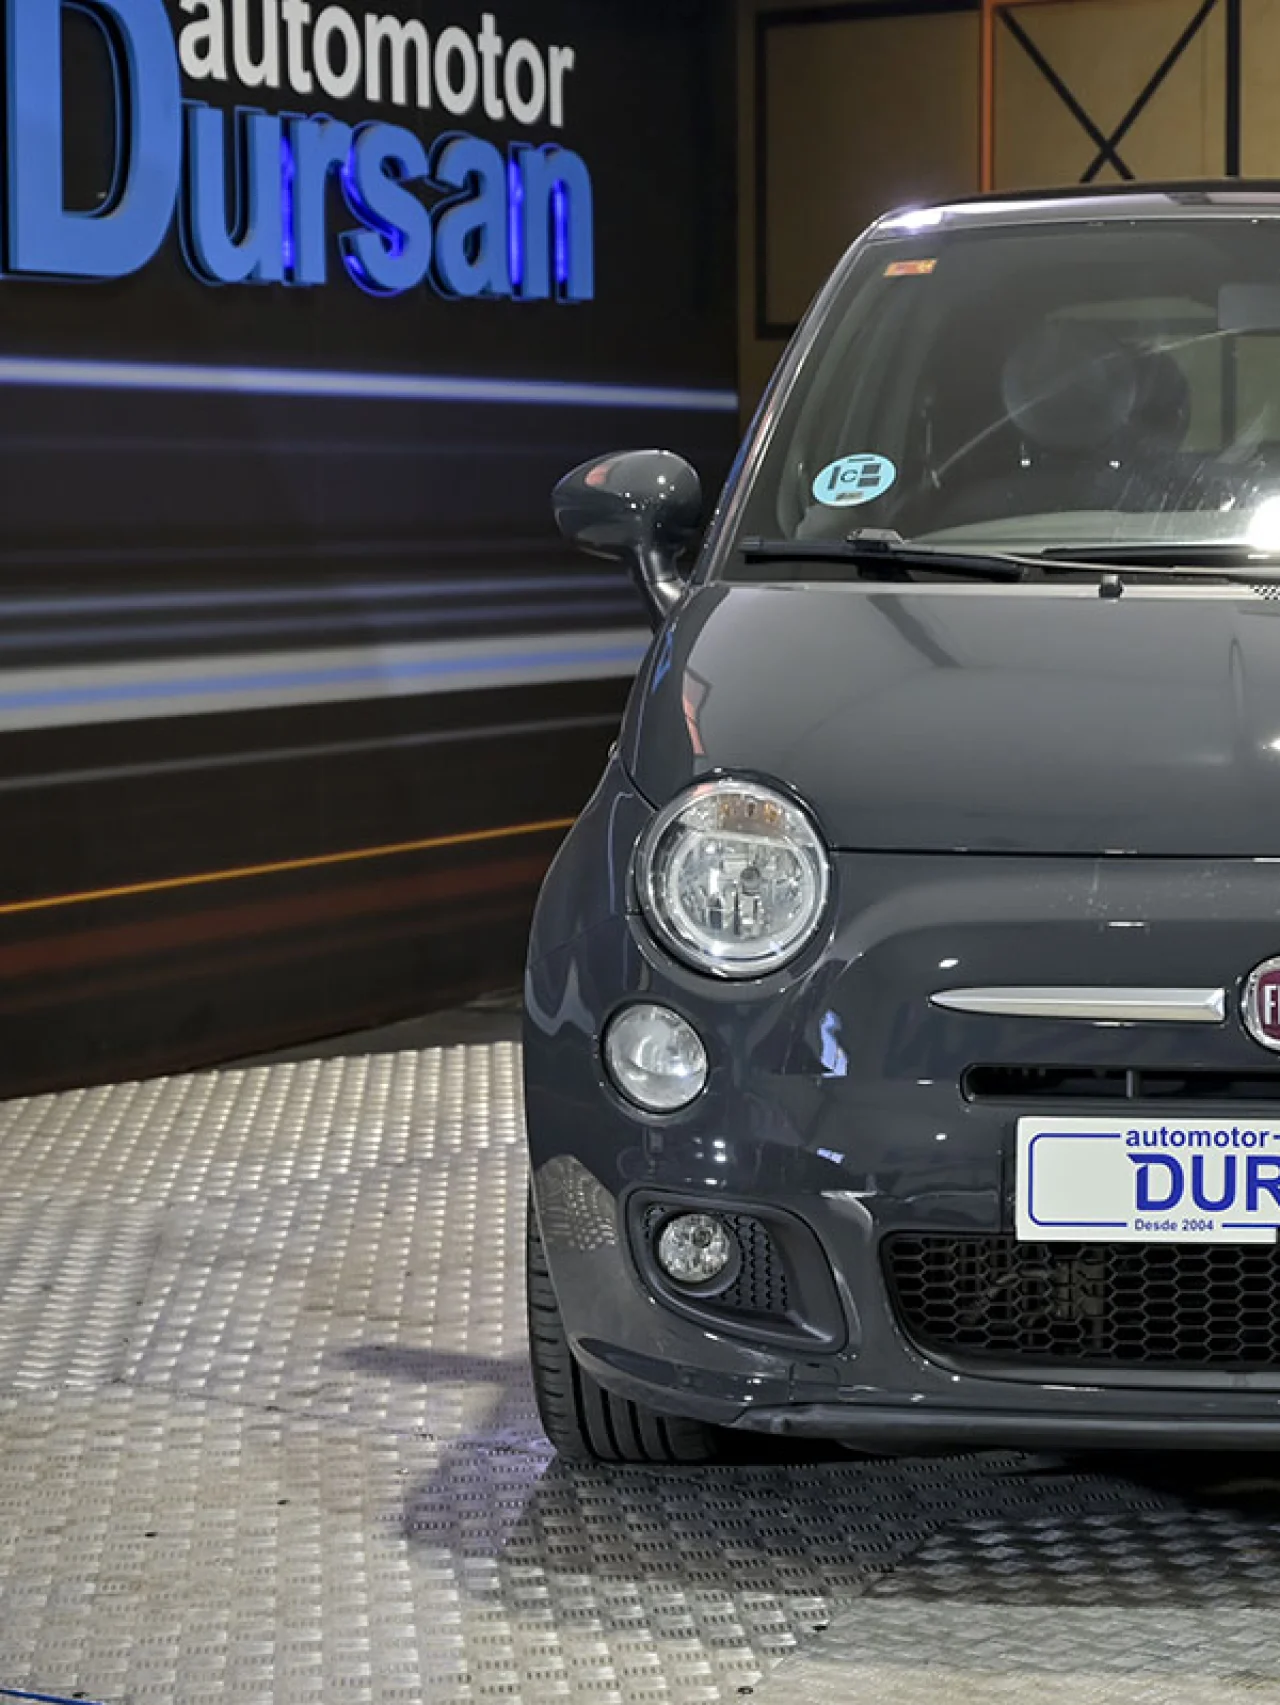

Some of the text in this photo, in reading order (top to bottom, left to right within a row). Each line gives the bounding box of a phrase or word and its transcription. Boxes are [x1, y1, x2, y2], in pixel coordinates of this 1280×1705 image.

[179, 0, 574, 127] automotor
[6, 0, 594, 301] Dursan
[1126, 1127, 1270, 1148] automotor
[1134, 1218, 1214, 1231] Desde 2004
